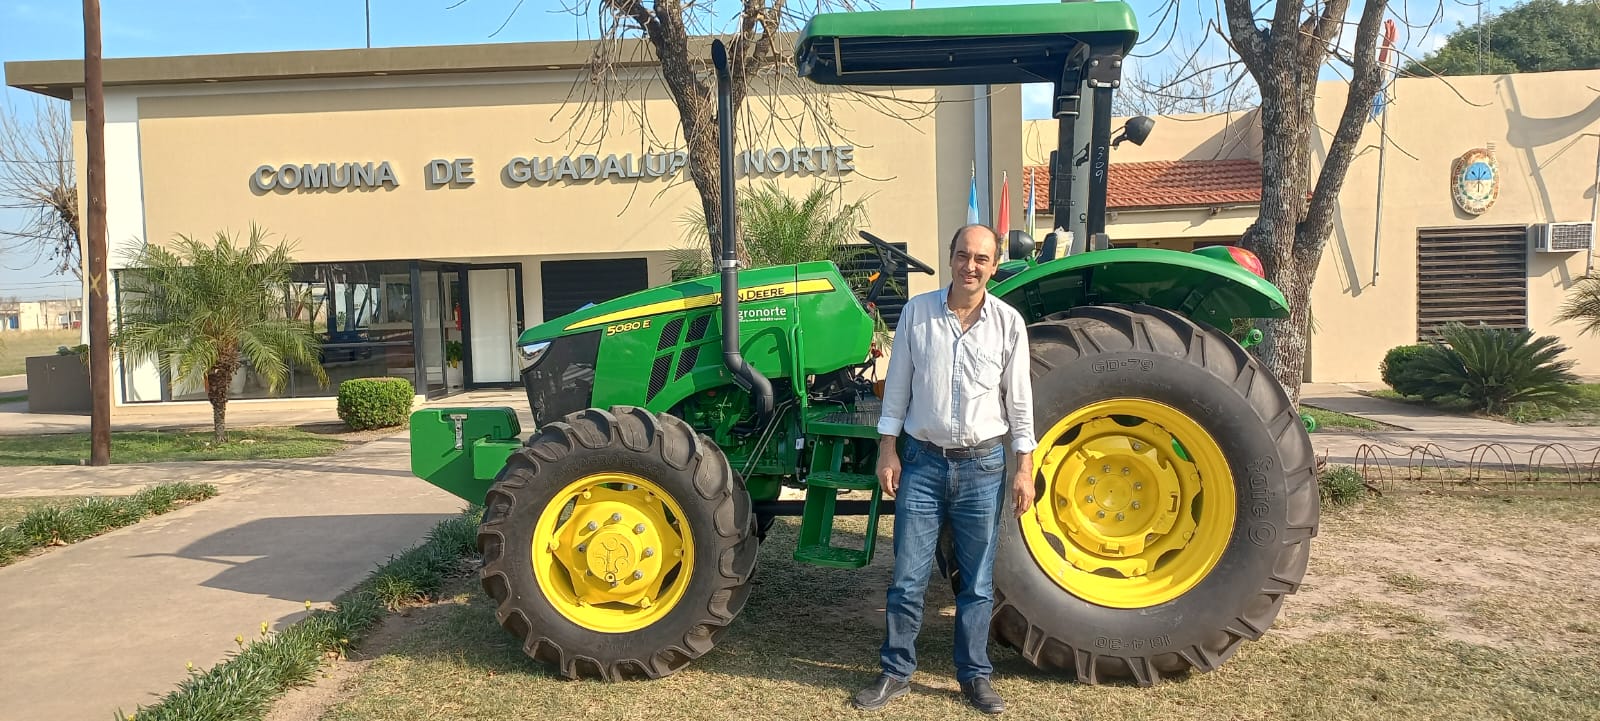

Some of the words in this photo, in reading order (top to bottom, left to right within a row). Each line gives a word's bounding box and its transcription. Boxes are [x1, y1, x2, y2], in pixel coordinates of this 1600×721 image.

[253, 160, 399, 192] COMUNA
[430, 158, 477, 186] DE
[506, 152, 687, 184] GUADALUP
[743, 145, 855, 175] NORTE
[746, 287, 785, 300] DEERE
[738, 306, 787, 320] gronorte
[606, 322, 640, 336] 5080
[642, 320, 651, 330] E
